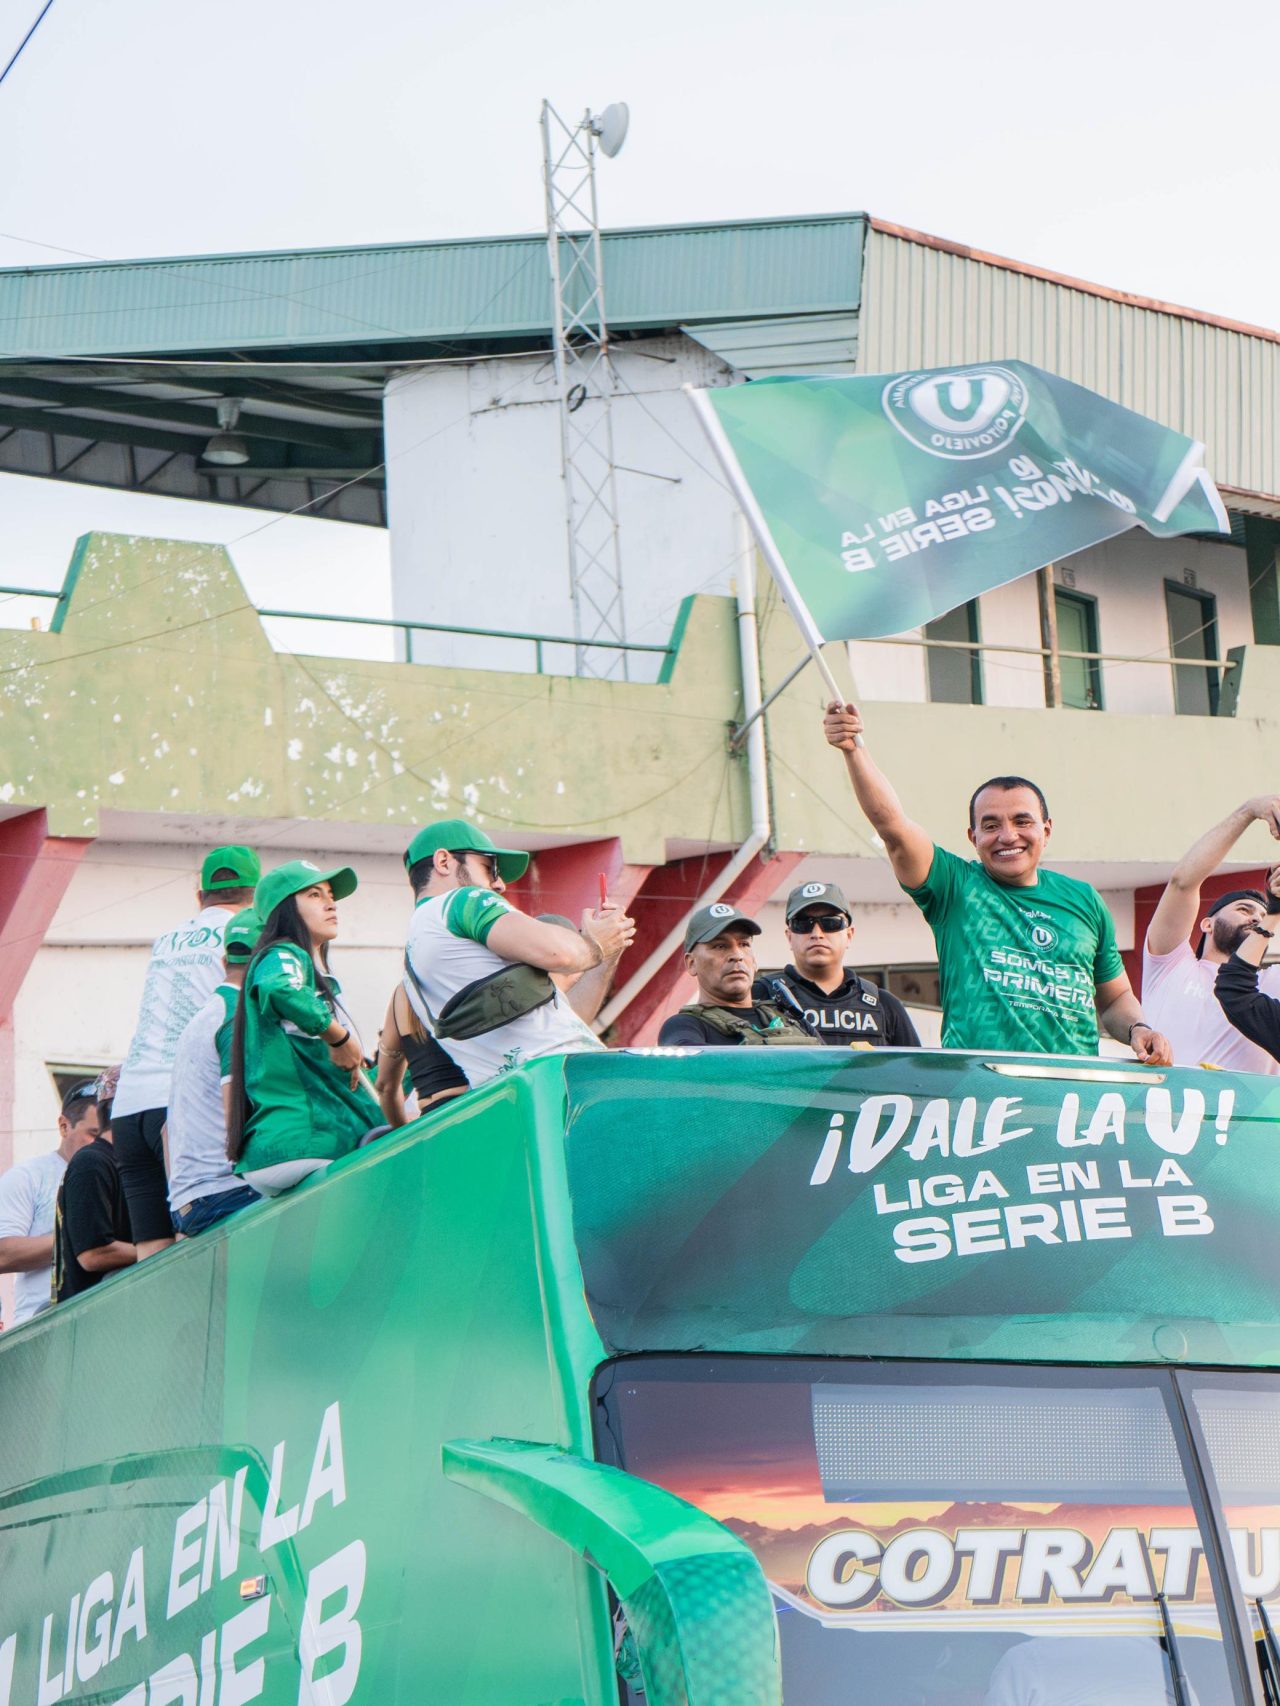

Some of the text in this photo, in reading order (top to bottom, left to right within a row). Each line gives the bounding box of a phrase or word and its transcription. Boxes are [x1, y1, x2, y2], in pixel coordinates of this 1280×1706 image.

[803, 1008, 879, 1032] OLICIA
[983, 967, 1096, 1010] PRIMERA
[809, 1087, 1236, 1186] ¡DALE LA U!
[873, 1158, 1194, 1215] LIGA EN LA
[892, 1194, 1215, 1264] SERIE B
[37, 1545, 148, 1706] LIGA
[166, 1464, 249, 1620] EN
[259, 1400, 347, 1553] LA
[297, 1538, 367, 1706] B
